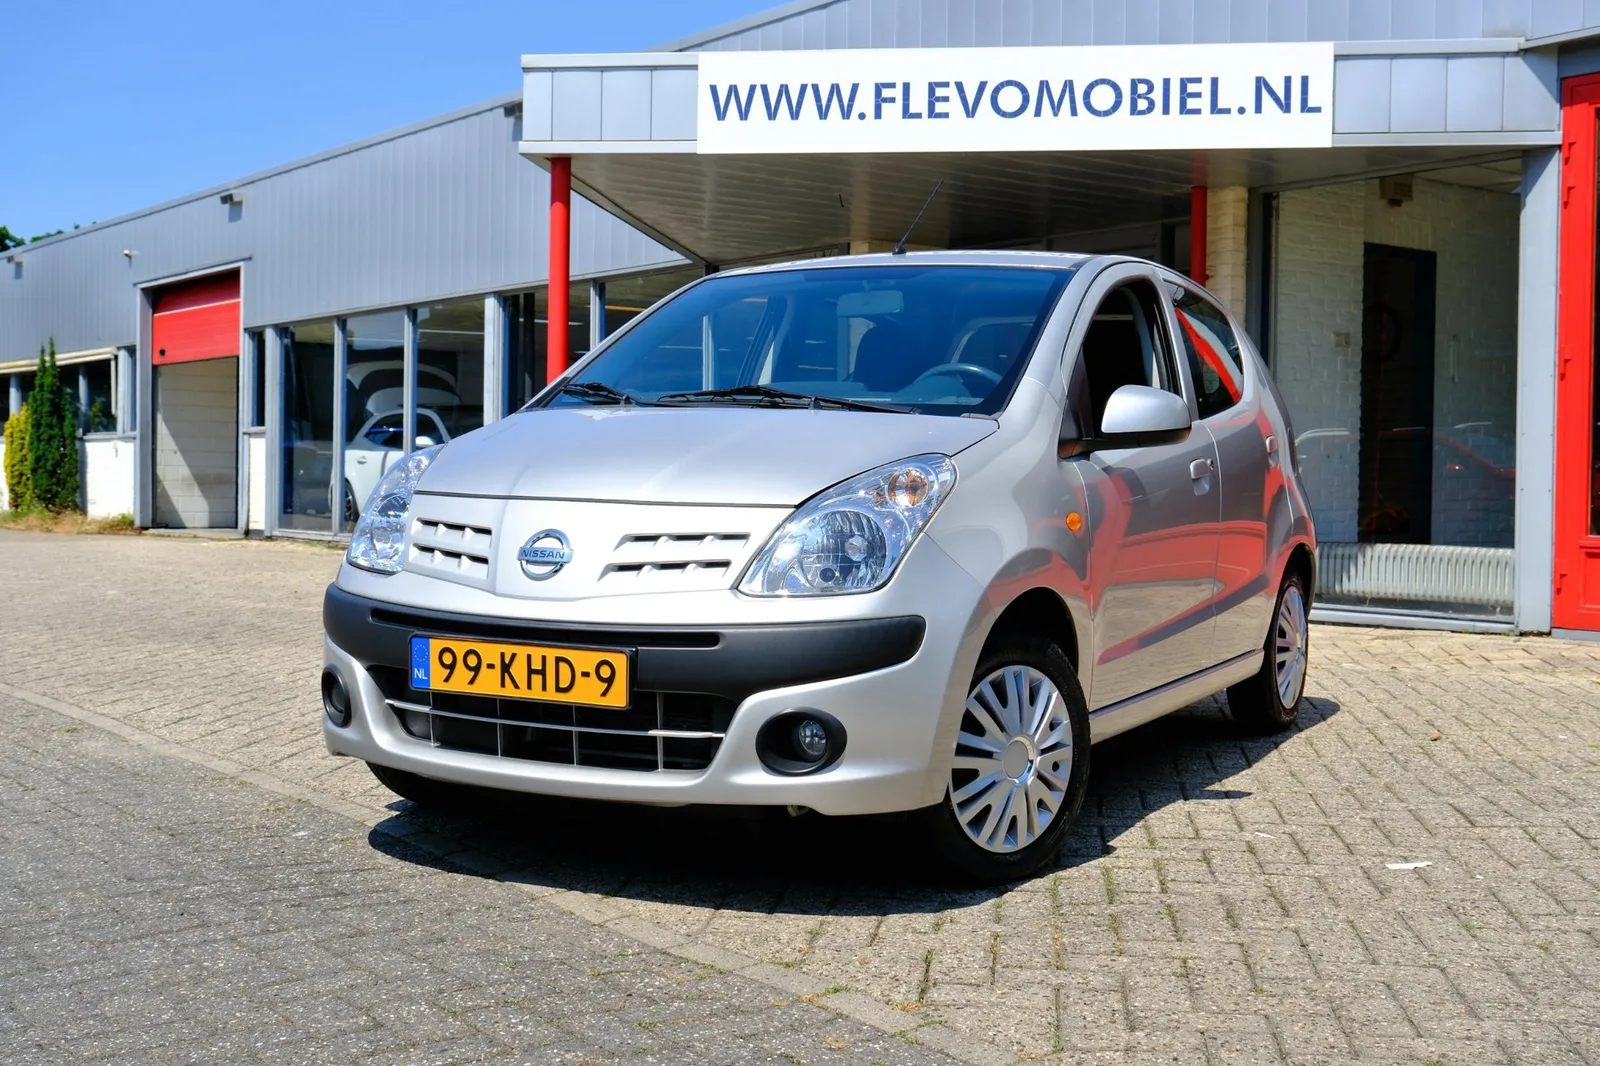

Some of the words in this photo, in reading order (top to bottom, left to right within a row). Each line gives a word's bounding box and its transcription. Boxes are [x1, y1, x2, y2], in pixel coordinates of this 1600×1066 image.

[709, 75, 1322, 121] WWW.FLEVOMOBIEL.NL
[521, 549, 566, 560] NISSAN
[414, 668, 428, 680] NL
[438, 646, 616, 697] 99-KHD-9
